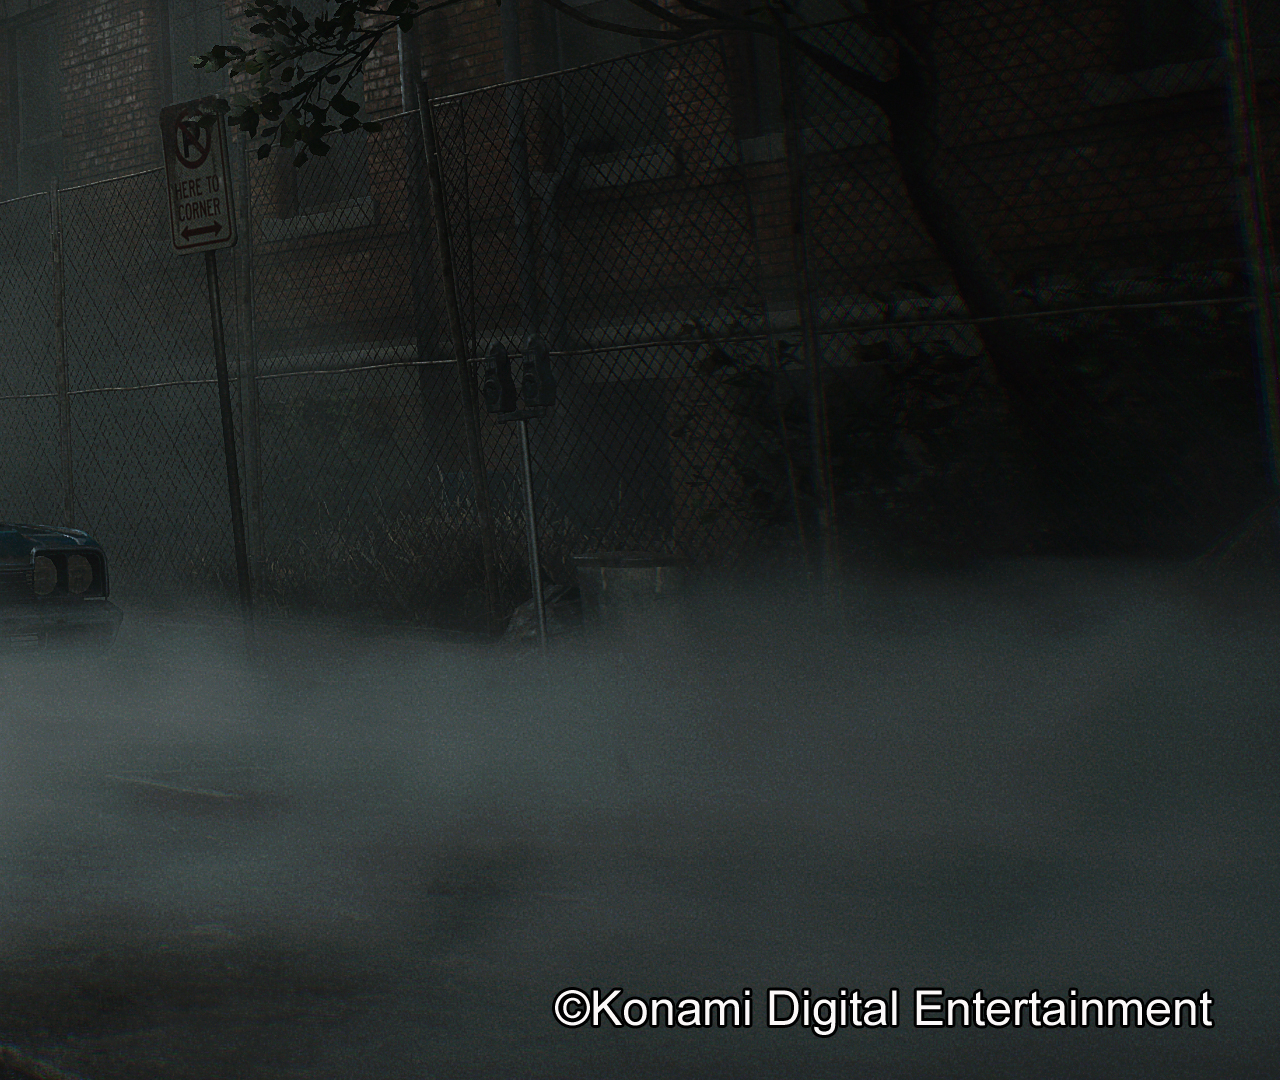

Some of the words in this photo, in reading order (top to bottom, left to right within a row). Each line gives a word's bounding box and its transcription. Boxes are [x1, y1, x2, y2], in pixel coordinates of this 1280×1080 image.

[175, 178, 203, 200] HERE
[206, 174, 220, 193] TO
[178, 197, 221, 222] CORNER
